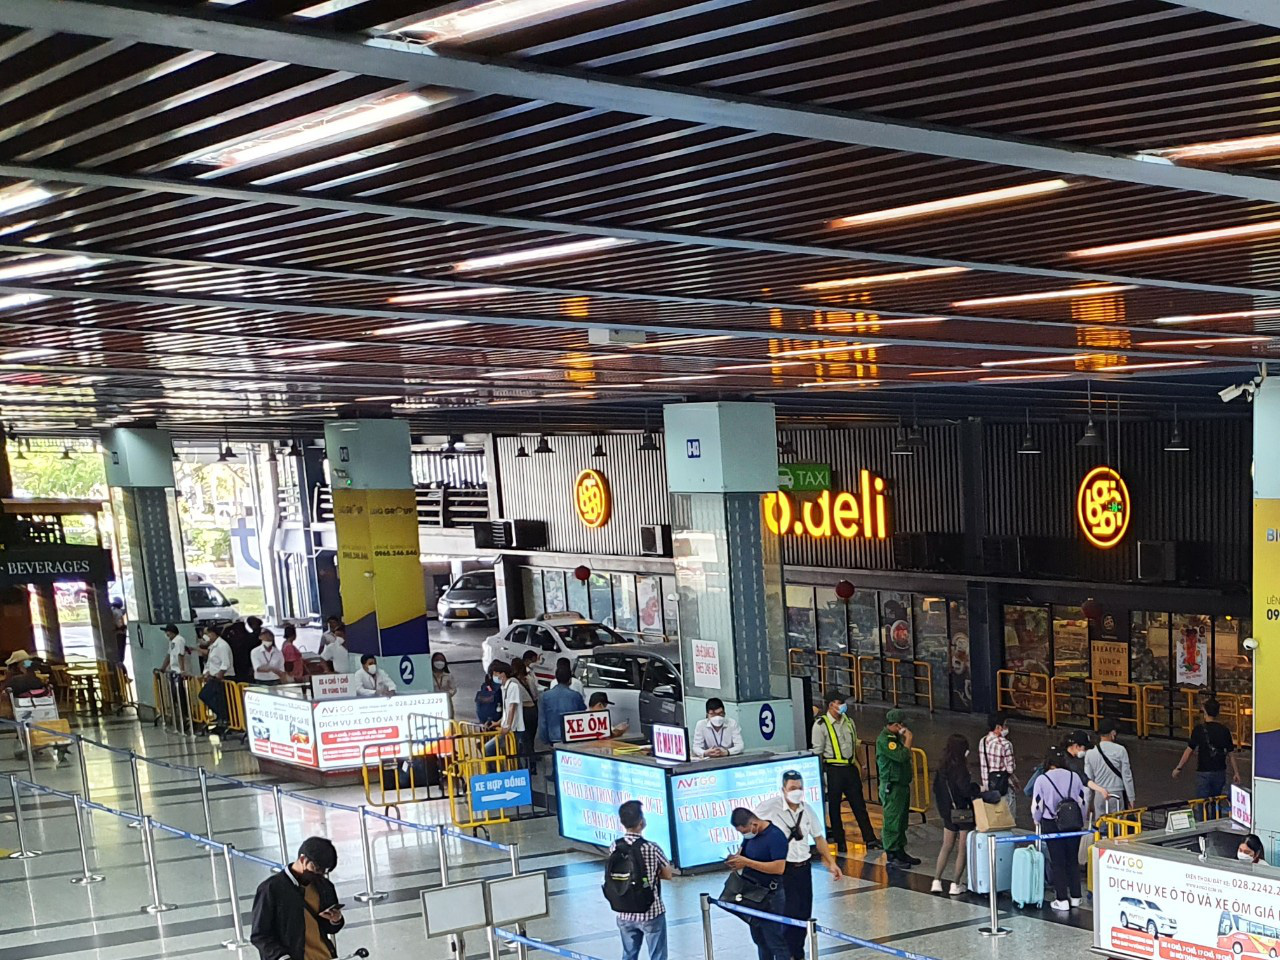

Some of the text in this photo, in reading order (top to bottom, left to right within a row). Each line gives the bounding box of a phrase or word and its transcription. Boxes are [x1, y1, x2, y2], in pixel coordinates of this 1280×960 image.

[796, 471, 828, 485] TAXI
[7, 561, 90, 574] BEVERAGES
[1267, 595, 1280, 605] LIÊN
[401, 662, 413, 680] 2
[567, 714, 607, 733] XE ÔM
[762, 711, 772, 733] 3
[475, 775, 526, 791] XE HỢP ĐỒNG
[1109, 876, 1133, 892] DỊCH
[1137, 882, 1151, 898] VỤ
[1154, 886, 1167, 898] XE
[1170, 887, 1178, 900] Ô
[1181, 889, 1195, 903] TÔ
[1197, 893, 1212, 907] VÀ
[1215, 898, 1229, 911] XE
[1232, 901, 1251, 915] ÔM
[1254, 905, 1275, 919] GIÁ
